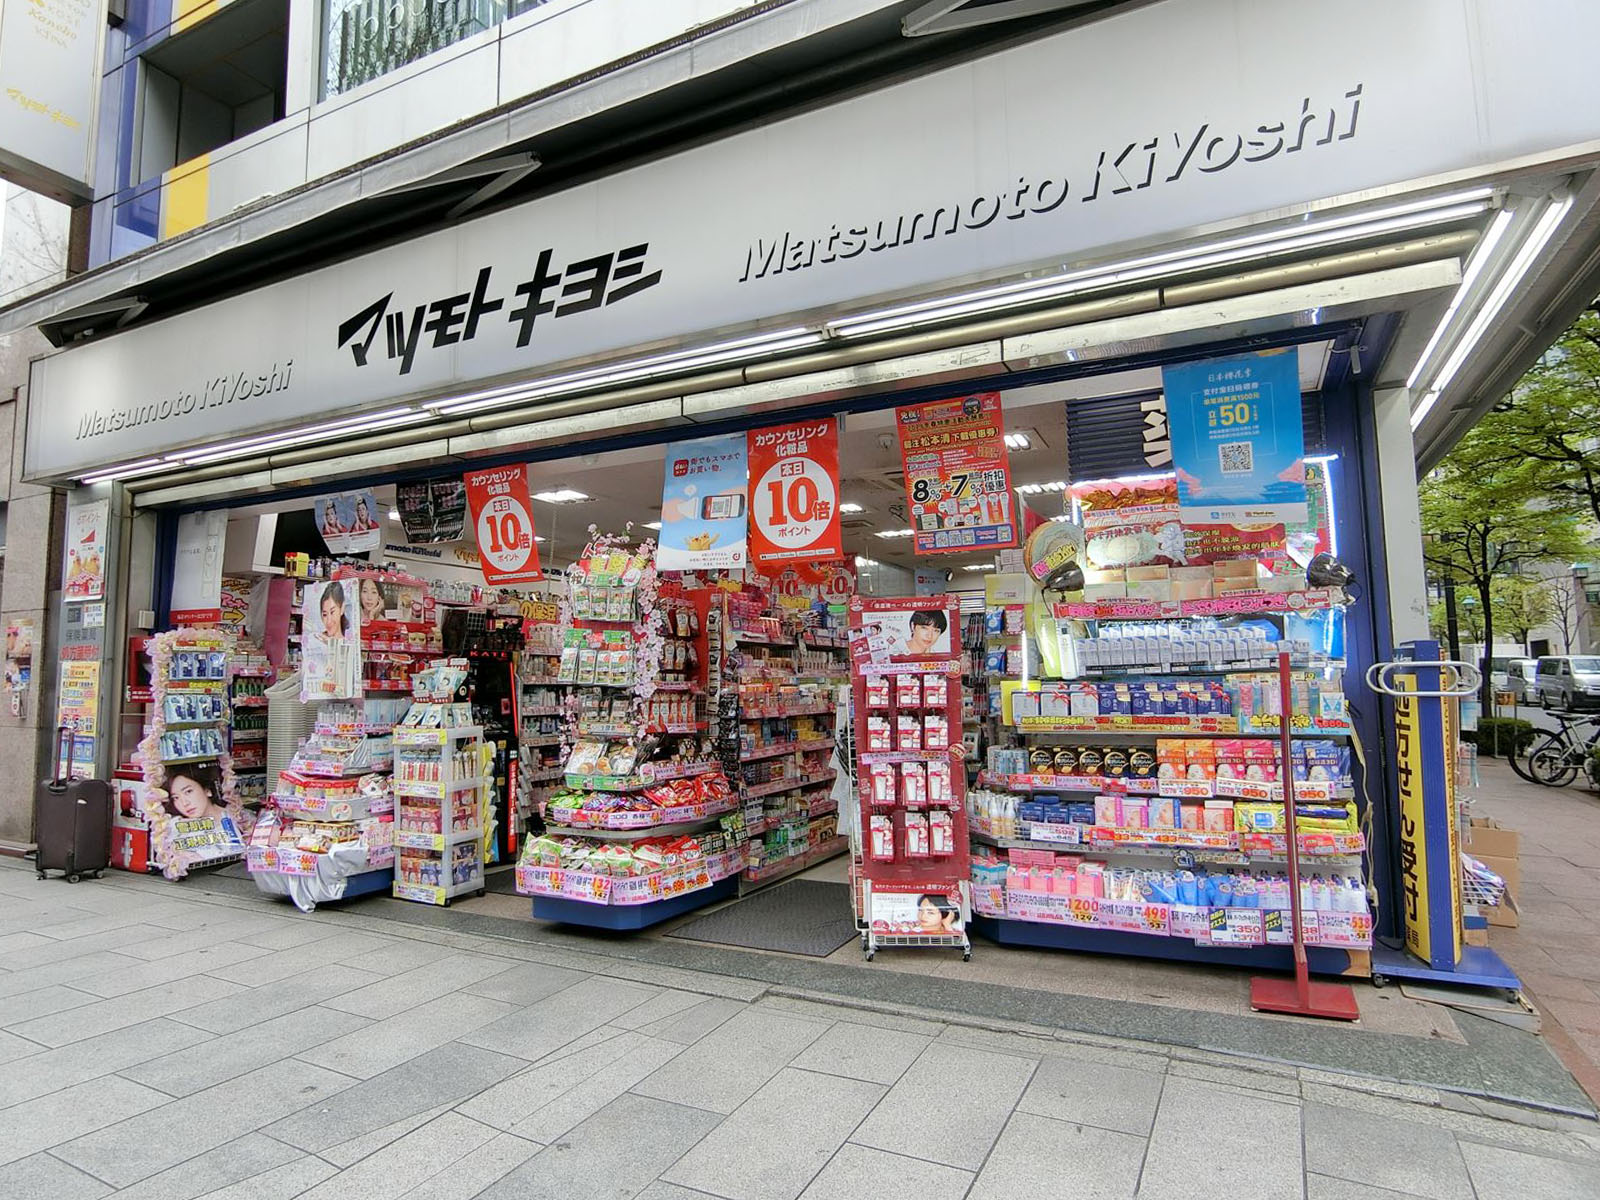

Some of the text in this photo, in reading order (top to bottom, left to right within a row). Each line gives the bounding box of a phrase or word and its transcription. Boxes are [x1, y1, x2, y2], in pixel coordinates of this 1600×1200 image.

[738, 83, 1363, 283] Matsumoto KiYoshi
[338, 242, 663, 376] マツモトキヨシ
[75, 360, 294, 441] Matsumoto KiYoshi
[1220, 402, 1250, 425] 50
[755, 424, 829, 446] カウンセリング
[775, 441, 808, 457] 化粧品
[471, 467, 521, 486] カウンセリング
[781, 462, 804, 477] 本日
[487, 484, 511, 496] 化粧品
[493, 501, 511, 512] 本日
[767, 477, 820, 526] 10
[812, 500, 831, 521] 倍
[486, 512, 522, 553] 10
[778, 526, 812, 538] ポイント
[518, 532, 531, 550] 倍
[497, 554, 520, 563] ポイント
[1183, 787, 1208, 795] 950
[1241, 788, 1268, 798] 950
[1300, 790, 1326, 799] 950
[1144, 905, 1168, 920] 498
[1351, 916, 1371, 931] 538
